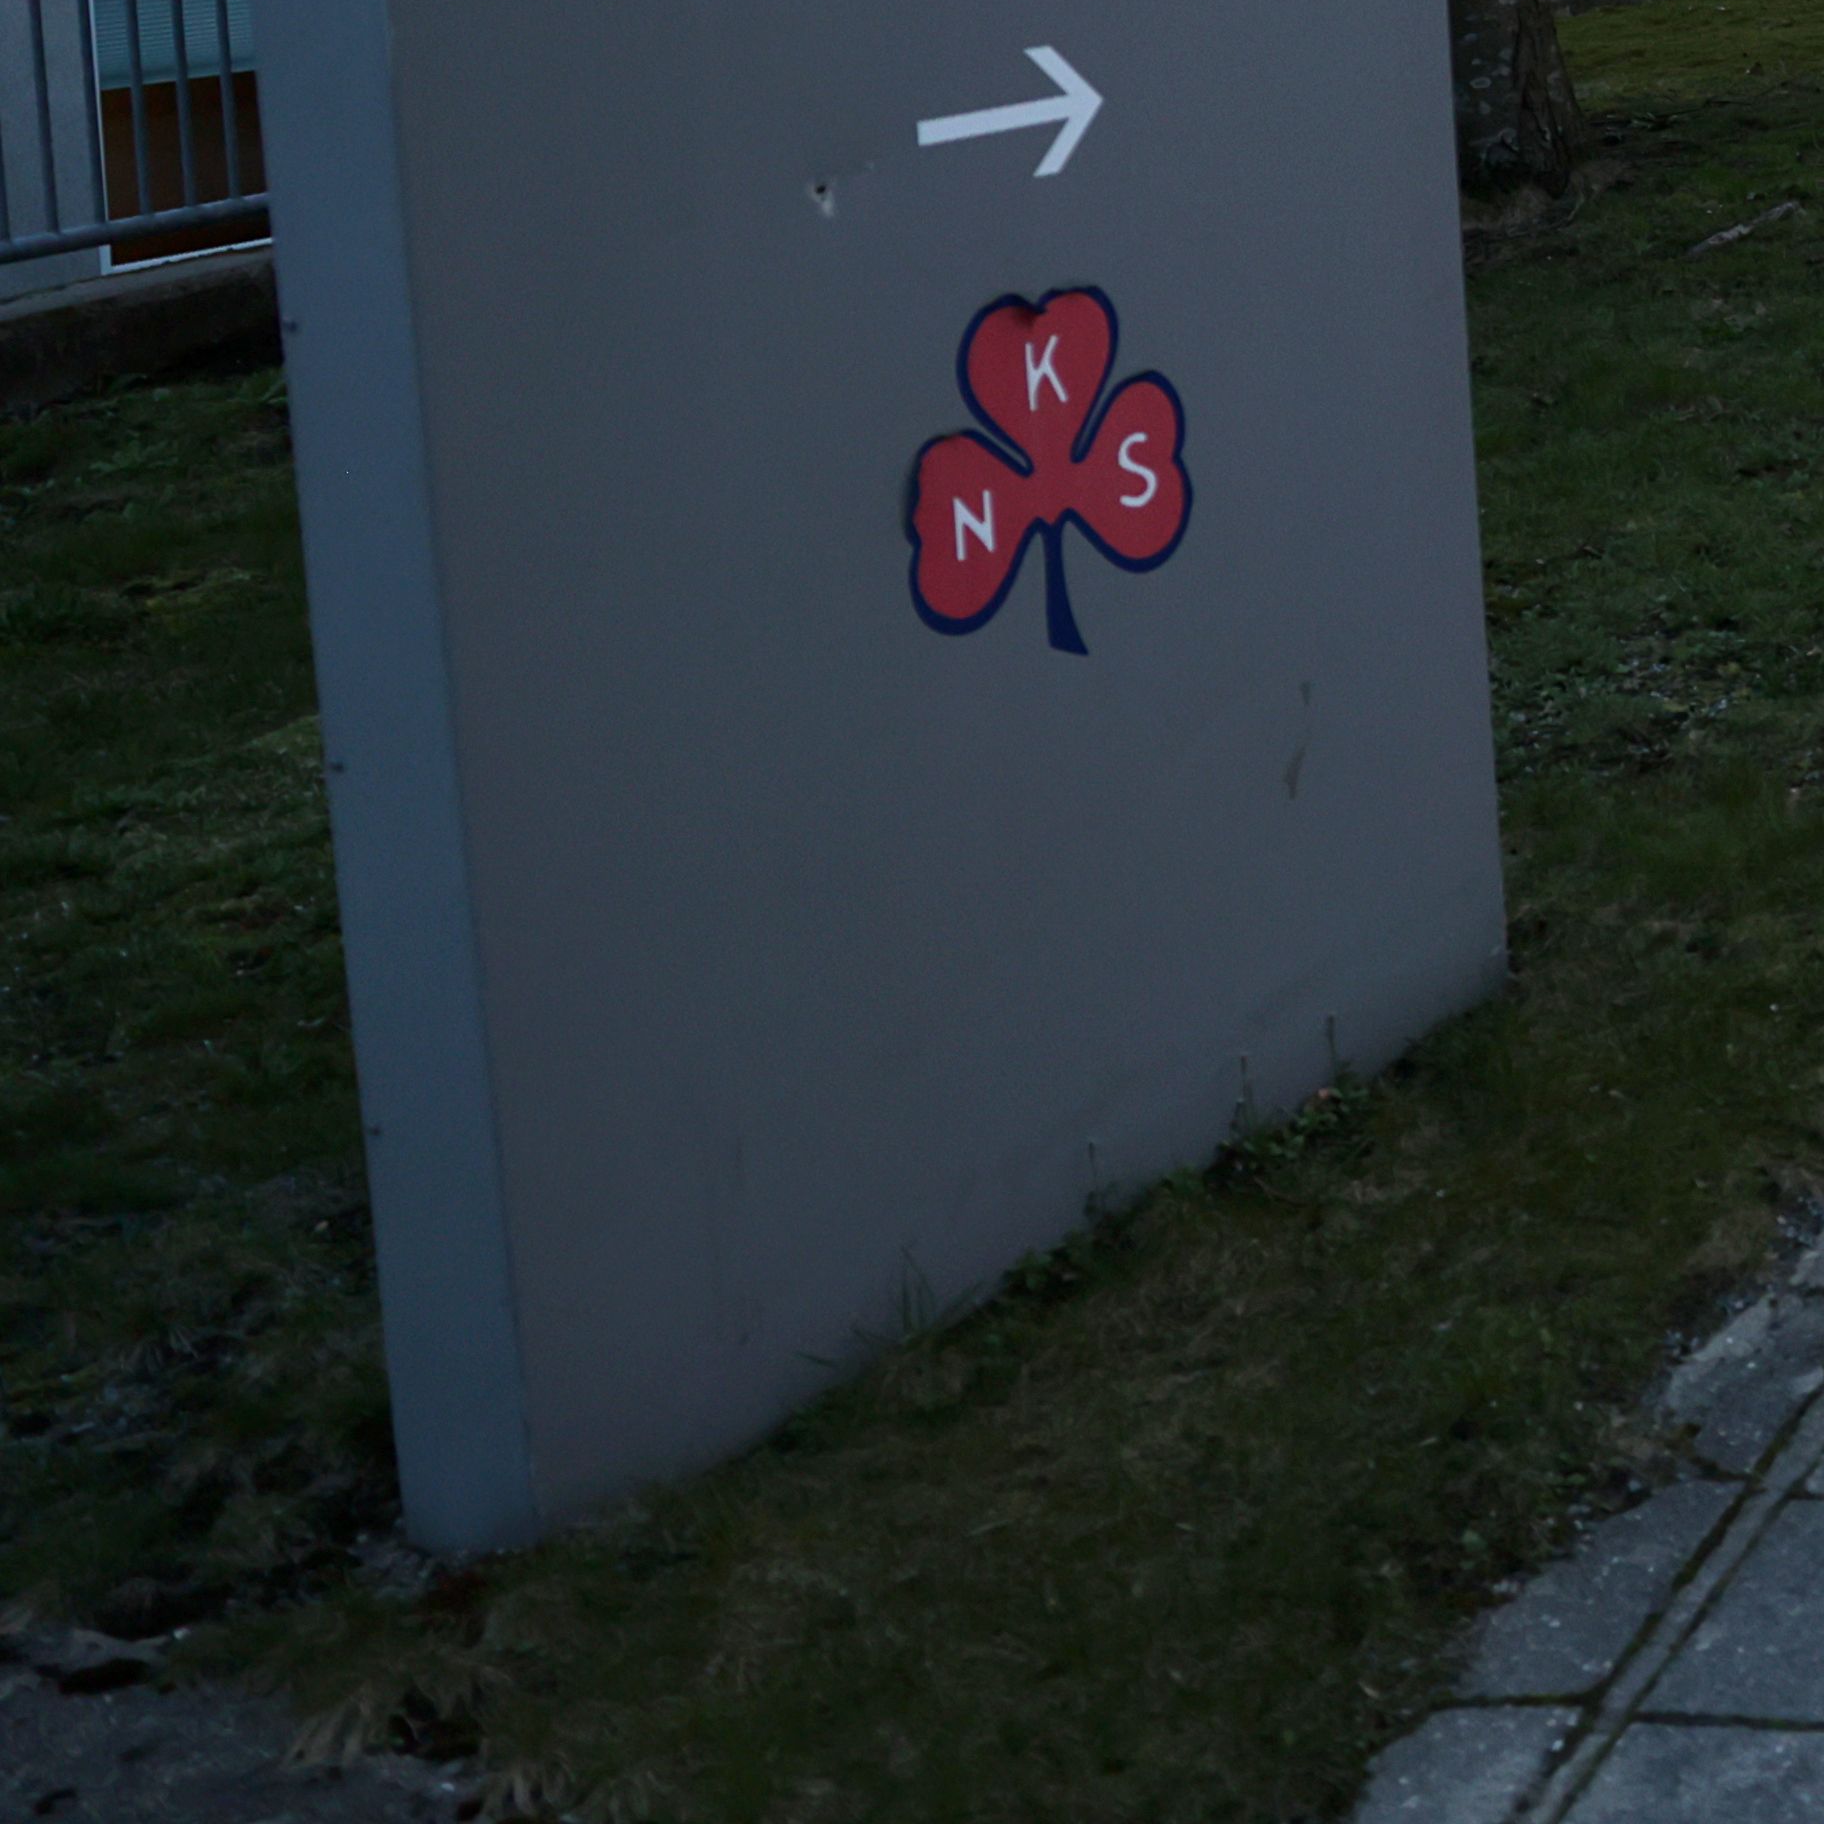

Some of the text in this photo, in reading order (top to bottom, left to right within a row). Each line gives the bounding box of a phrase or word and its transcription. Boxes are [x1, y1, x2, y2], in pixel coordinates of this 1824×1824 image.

[1025, 334, 1068, 412] K
[953, 432, 1158, 562] N S
